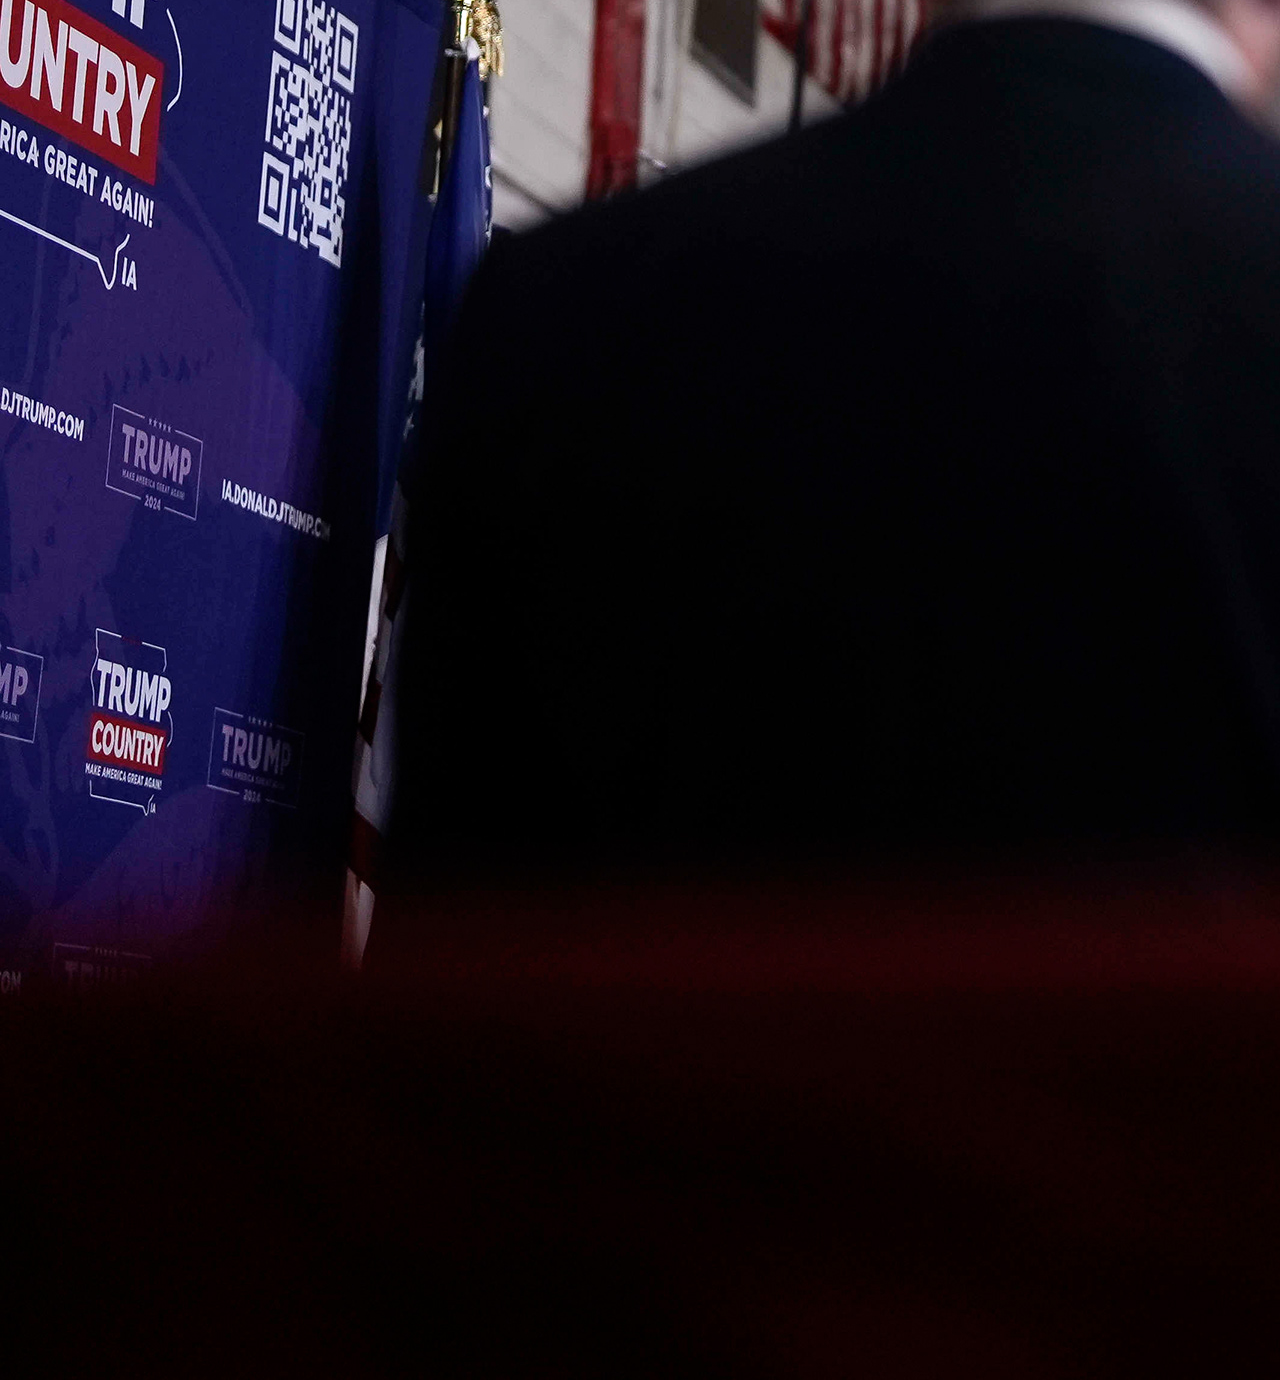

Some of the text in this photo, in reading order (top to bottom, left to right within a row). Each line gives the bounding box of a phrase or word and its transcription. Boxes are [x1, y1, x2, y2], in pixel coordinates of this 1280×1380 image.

[44, 144, 98, 198] GREAT
[100, 175, 155, 229] AGAIN!
[121, 256, 138, 291] IA
[0, 386, 85, 442] DJTRUMP.COM
[122, 422, 192, 486] TRUMP
[144, 494, 162, 511] 2024
[96, 657, 172, 723] TRUMP
[91, 719, 165, 768] COUNTRY
[221, 723, 293, 776] TRUMP
[85, 762, 102, 777] MAKE
[102, 766, 127, 783] AMERICA
[127, 772, 144, 787] GREAT
